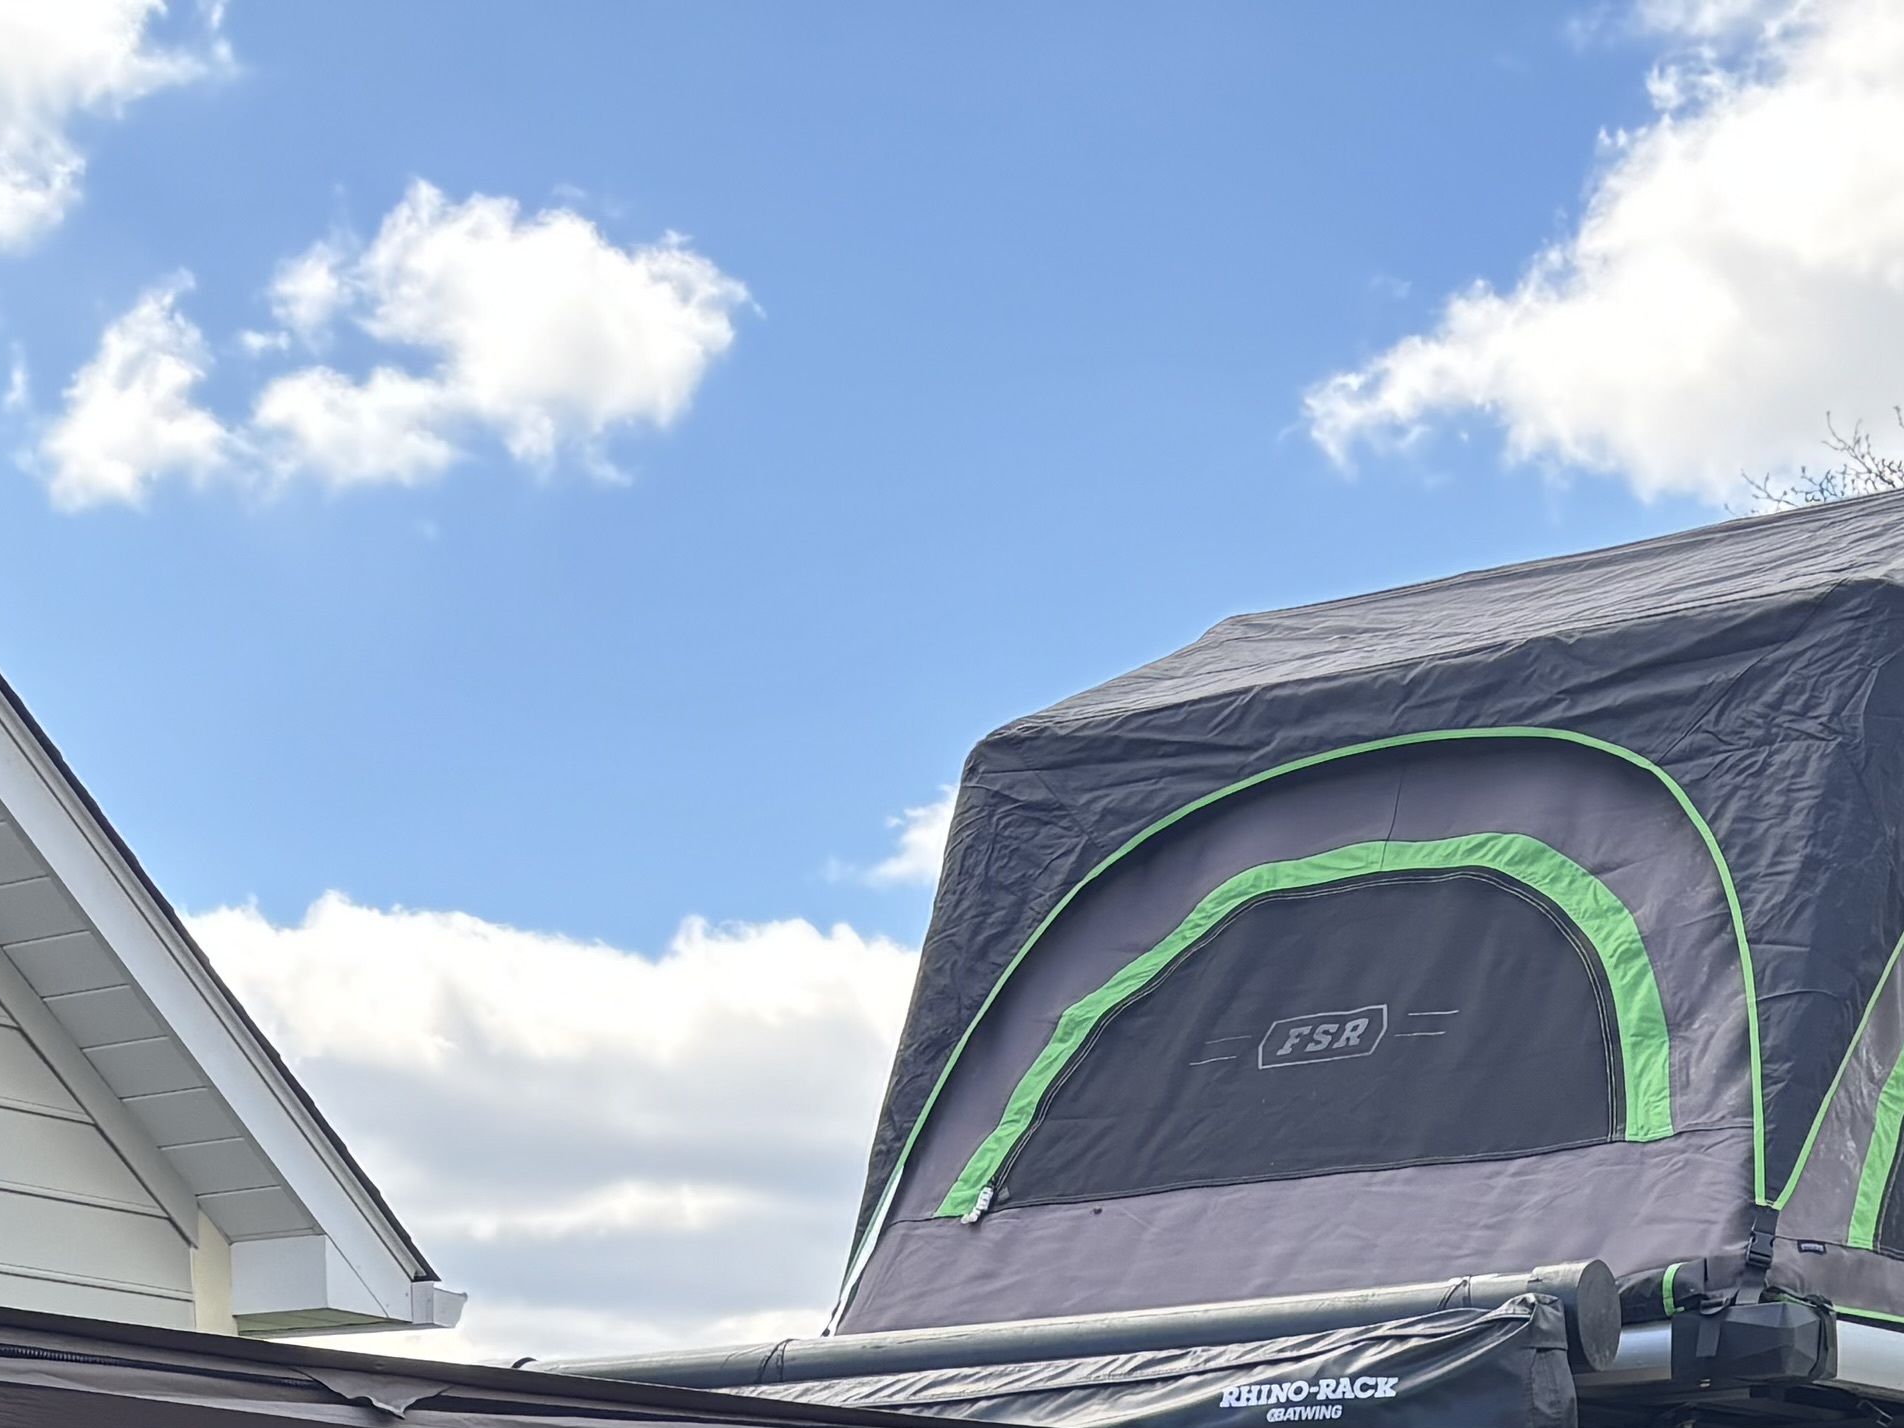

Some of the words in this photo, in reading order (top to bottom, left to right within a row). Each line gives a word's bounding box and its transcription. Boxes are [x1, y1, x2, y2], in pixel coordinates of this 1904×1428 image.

[1276, 1018, 1369, 1056] FSR
[1219, 1376, 1398, 1408] RHINO-RACK
[1272, 1405, 1343, 1422] BATWING
